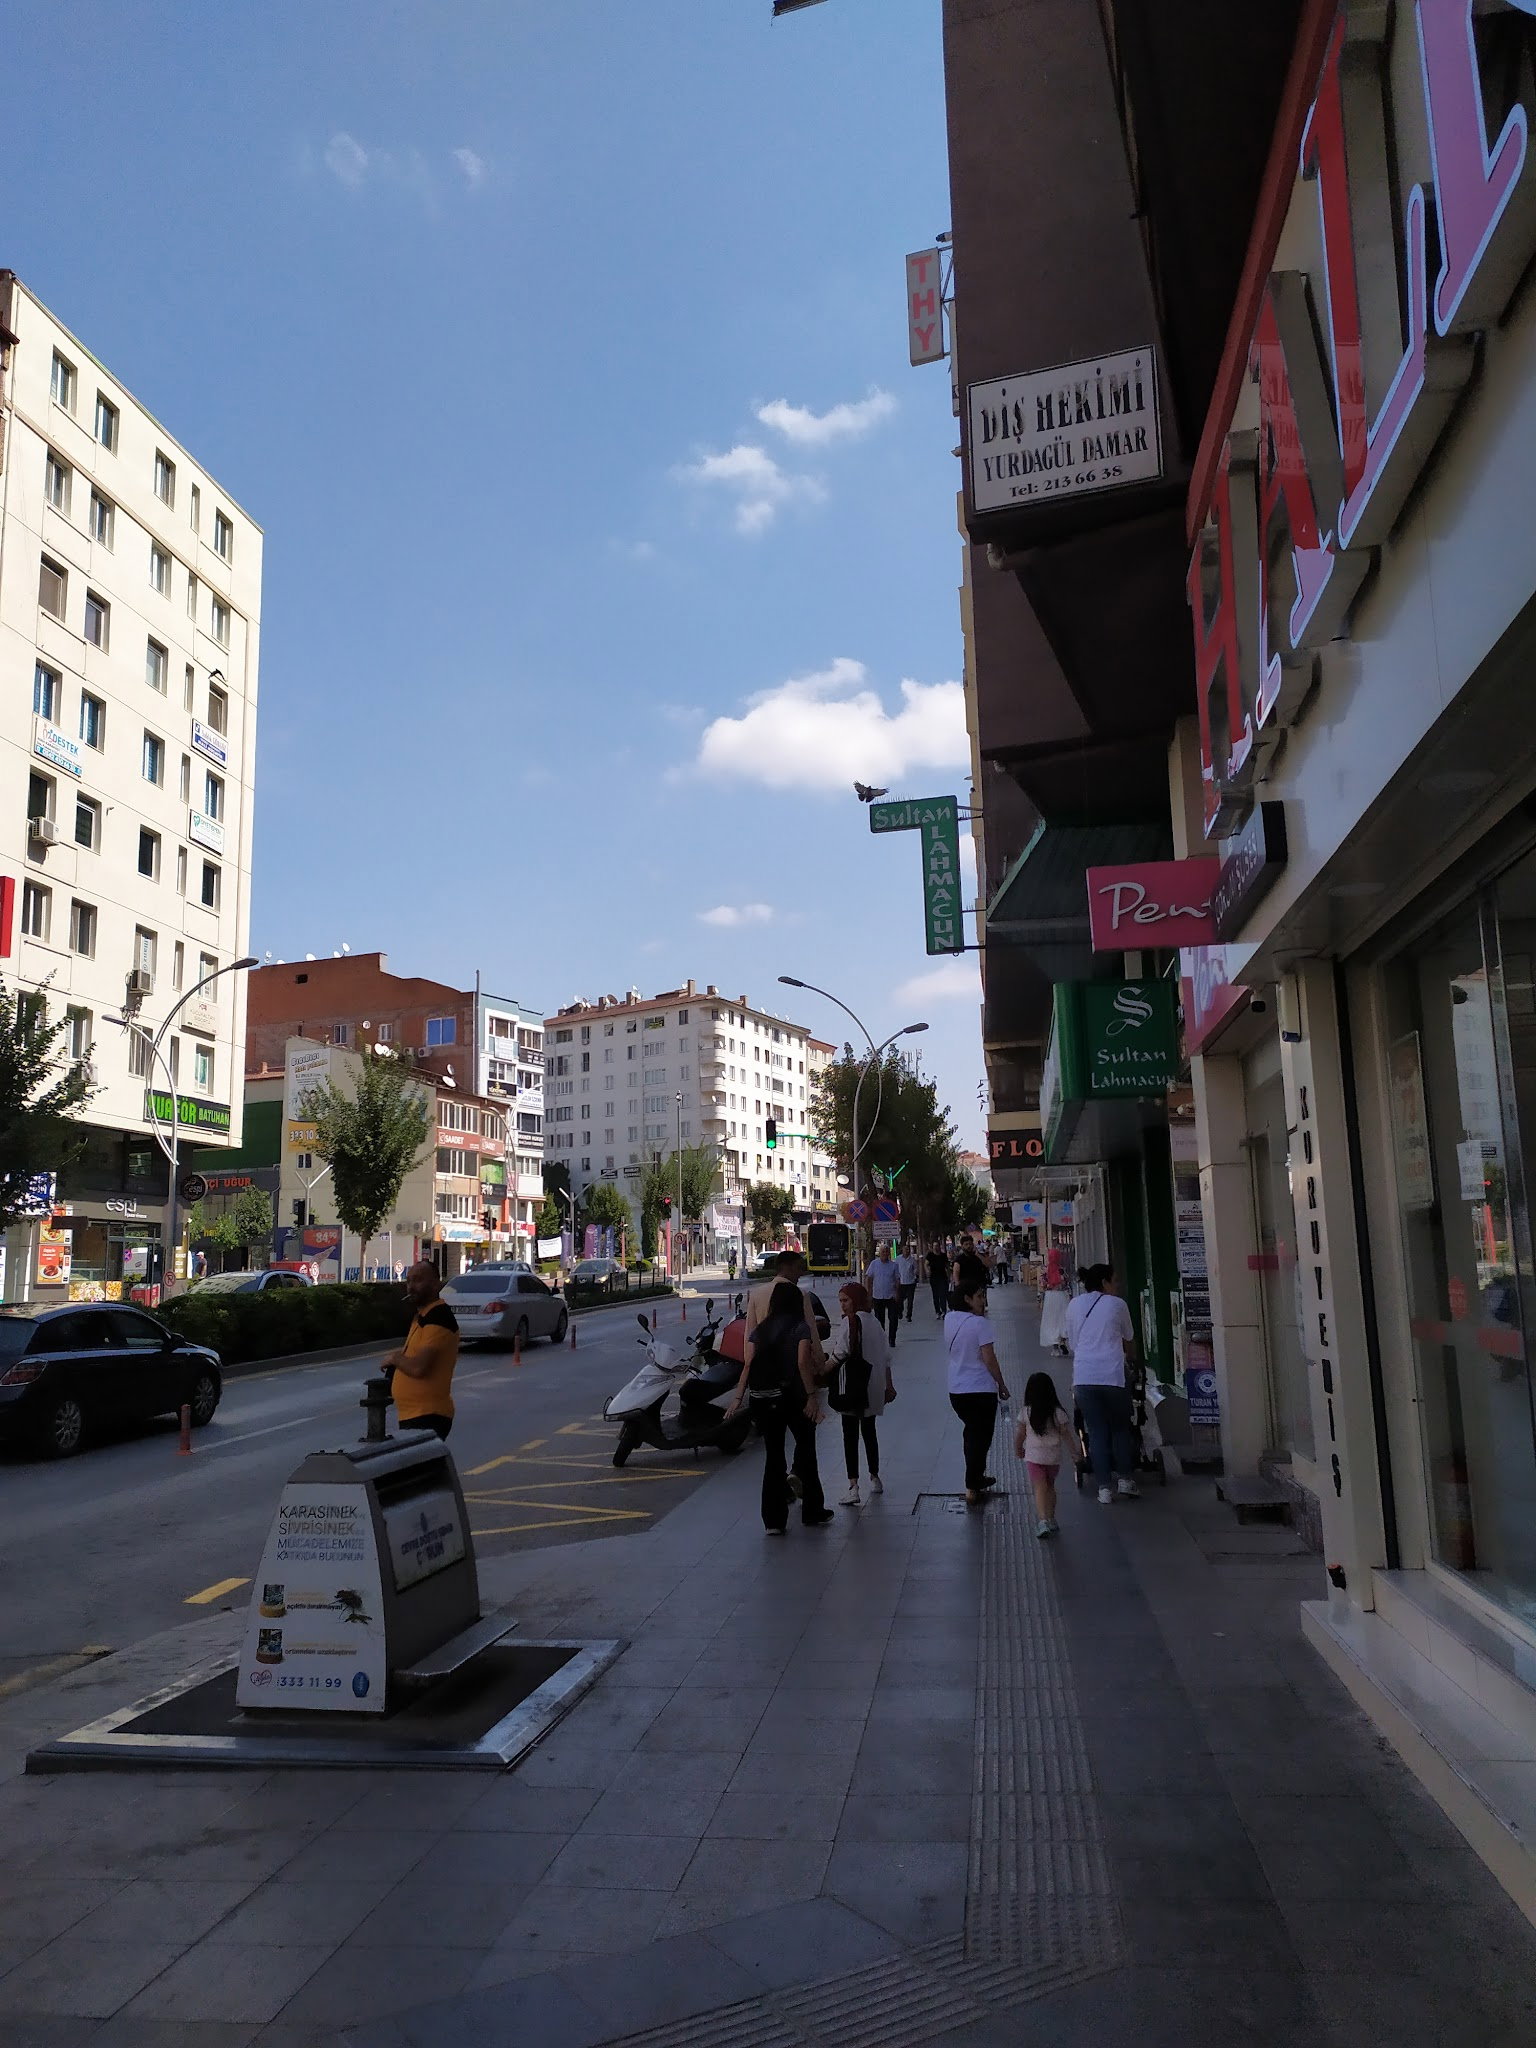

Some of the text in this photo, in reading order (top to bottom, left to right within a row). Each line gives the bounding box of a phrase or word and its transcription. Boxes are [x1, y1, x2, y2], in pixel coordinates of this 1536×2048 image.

[911, 255, 936, 352] THY
[981, 358, 1145, 444] DİŞ HEKİMİ
[983, 425, 1149, 482] YURDAGÜL DAMAR
[1009, 464, 1123, 498] Tel: 213 66 38
[53, 733, 80, 757] DESTEK
[874, 804, 951, 829] Sultan
[928, 825, 955, 951] LAHMACUN
[1098, 882, 1213, 930] Pen
[1096, 1046, 1167, 1065] Sultan
[199, 1107, 230, 1126] BATUHAN
[445, 1135, 465, 1145] SAADET
[106, 1198, 137, 1217] espi
[279, 1505, 358, 1519] KARASİNEK
[325, 1678, 342, 1688] 99
